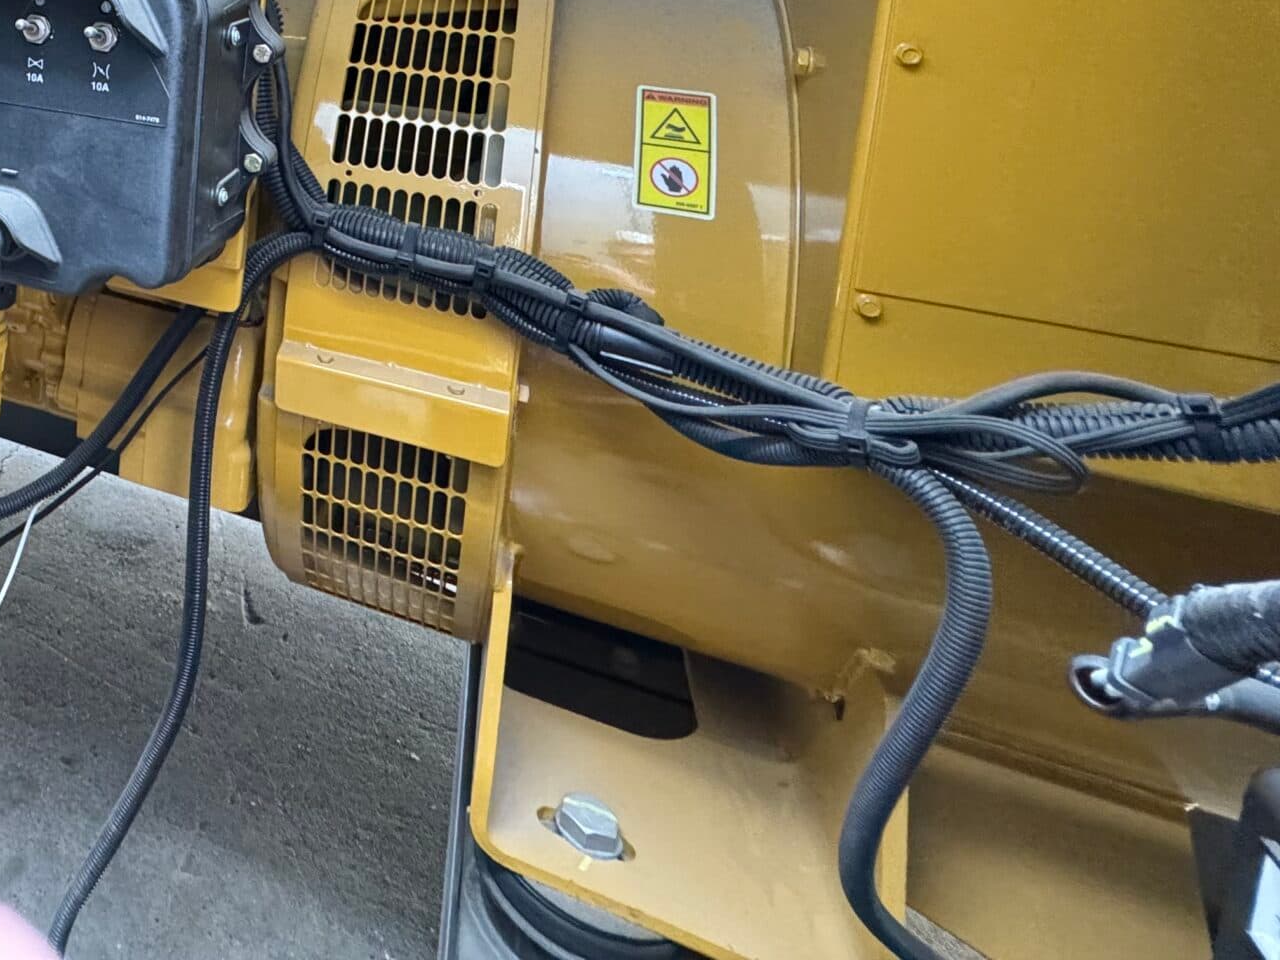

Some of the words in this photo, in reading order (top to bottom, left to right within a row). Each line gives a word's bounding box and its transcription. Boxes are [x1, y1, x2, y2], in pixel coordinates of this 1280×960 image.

[26, 72, 43, 83] 10A
[91, 81, 109, 92] 10A
[658, 95, 708, 106] WARNING
